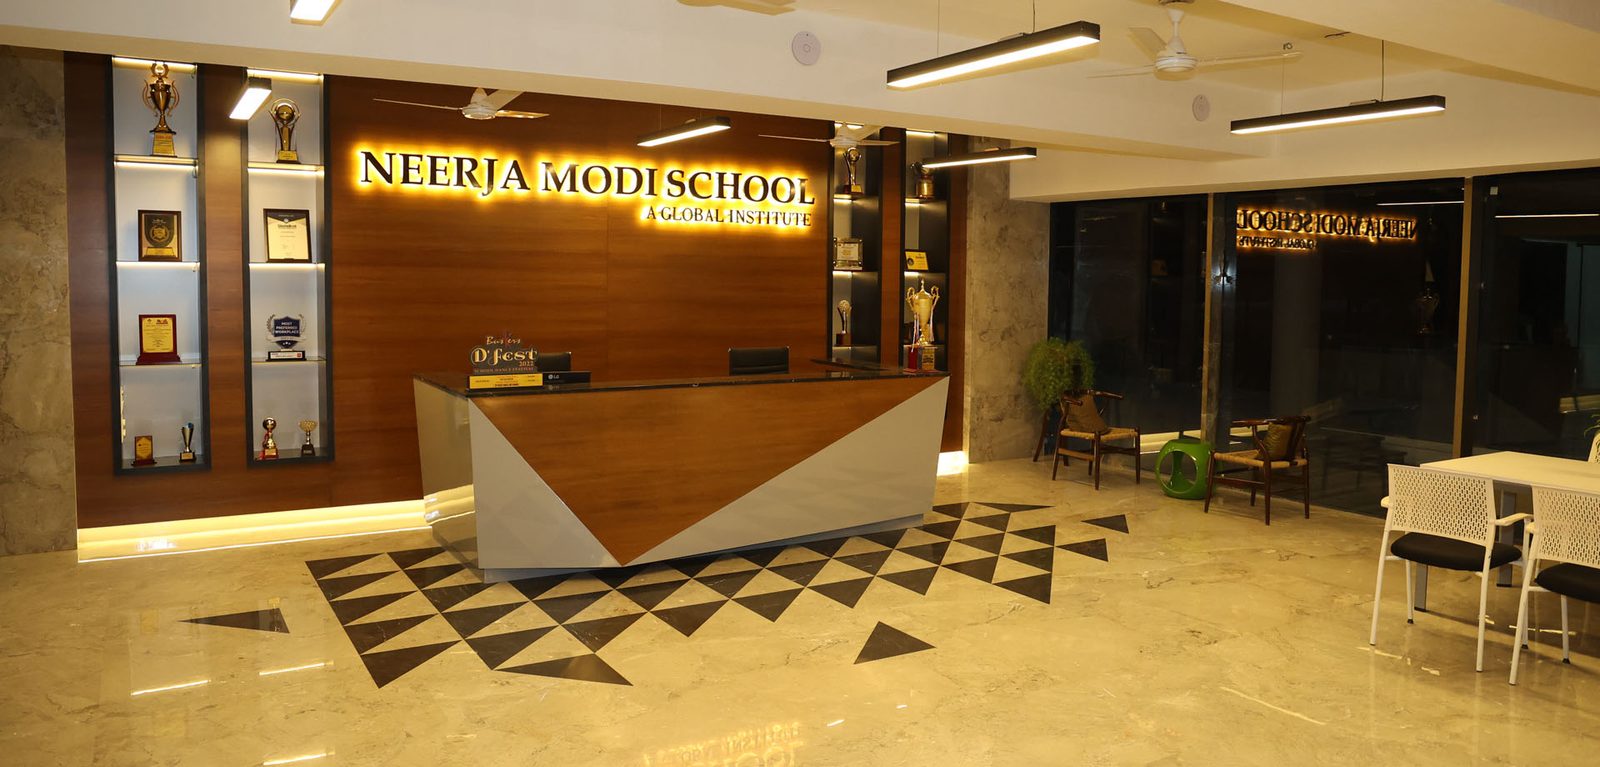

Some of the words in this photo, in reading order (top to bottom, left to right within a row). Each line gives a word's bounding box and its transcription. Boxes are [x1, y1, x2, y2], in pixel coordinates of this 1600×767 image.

[359, 150, 531, 197] NEERJA
[541, 161, 658, 196] MODI
[666, 169, 816, 205] SCHOOL
[646, 205, 657, 220] A
[660, 206, 725, 223] GLOBAL
[728, 209, 812, 227] INSTITUTE
